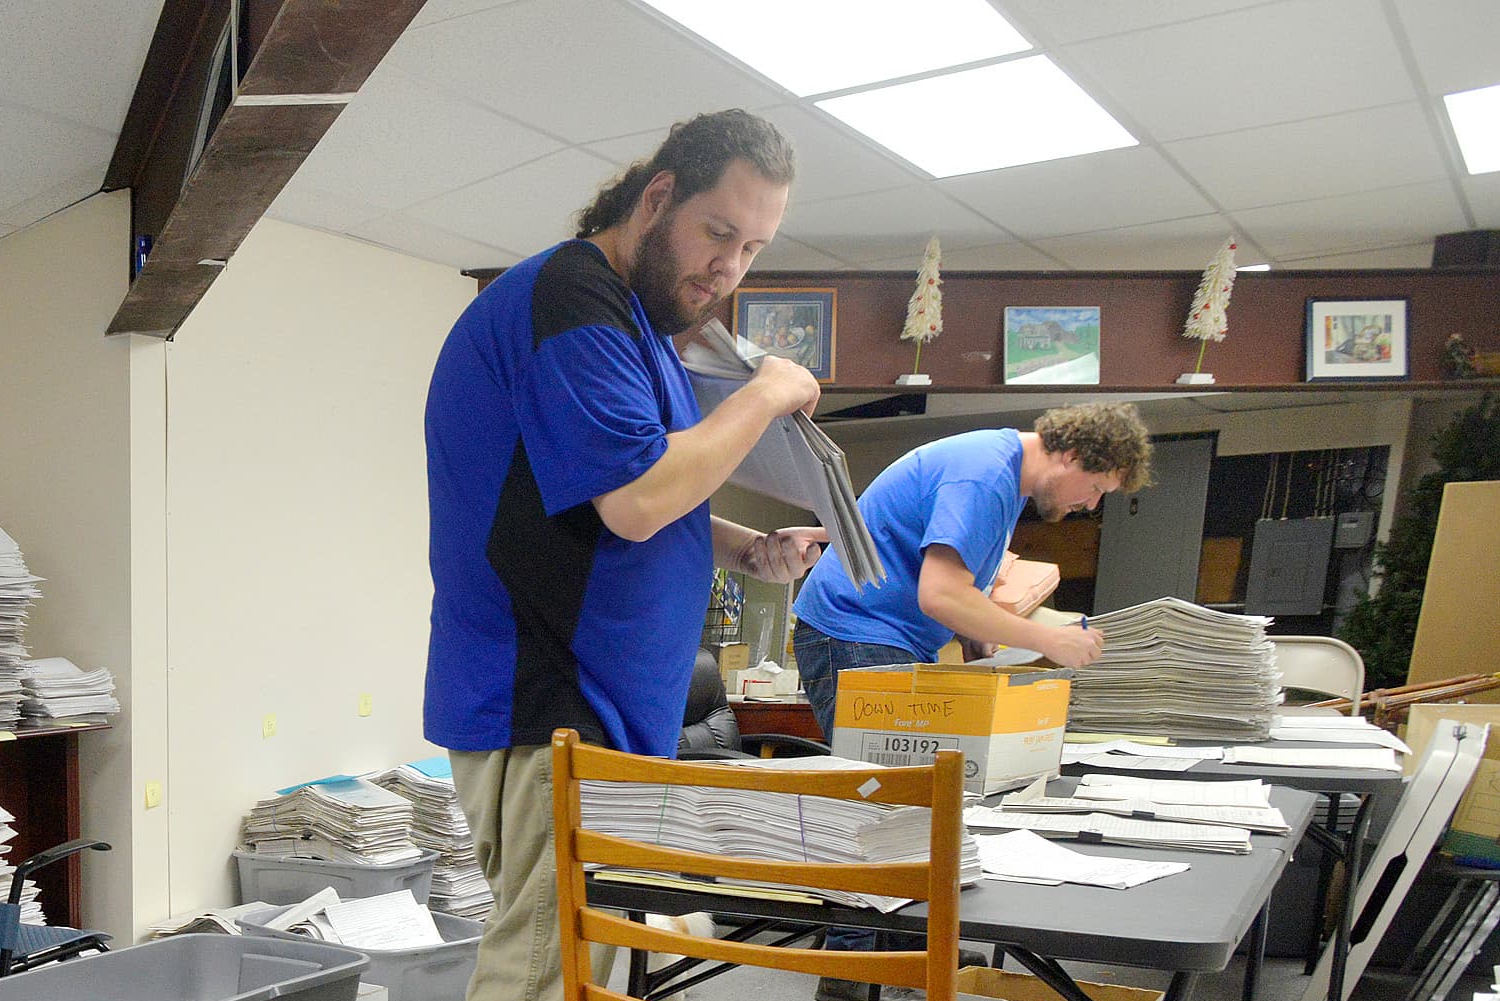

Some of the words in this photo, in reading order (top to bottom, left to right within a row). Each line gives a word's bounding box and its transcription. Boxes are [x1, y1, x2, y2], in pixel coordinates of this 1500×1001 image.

[853, 696, 894, 720] DOWN
[908, 699, 956, 717] TIME
[885, 737, 940, 754] 103192
